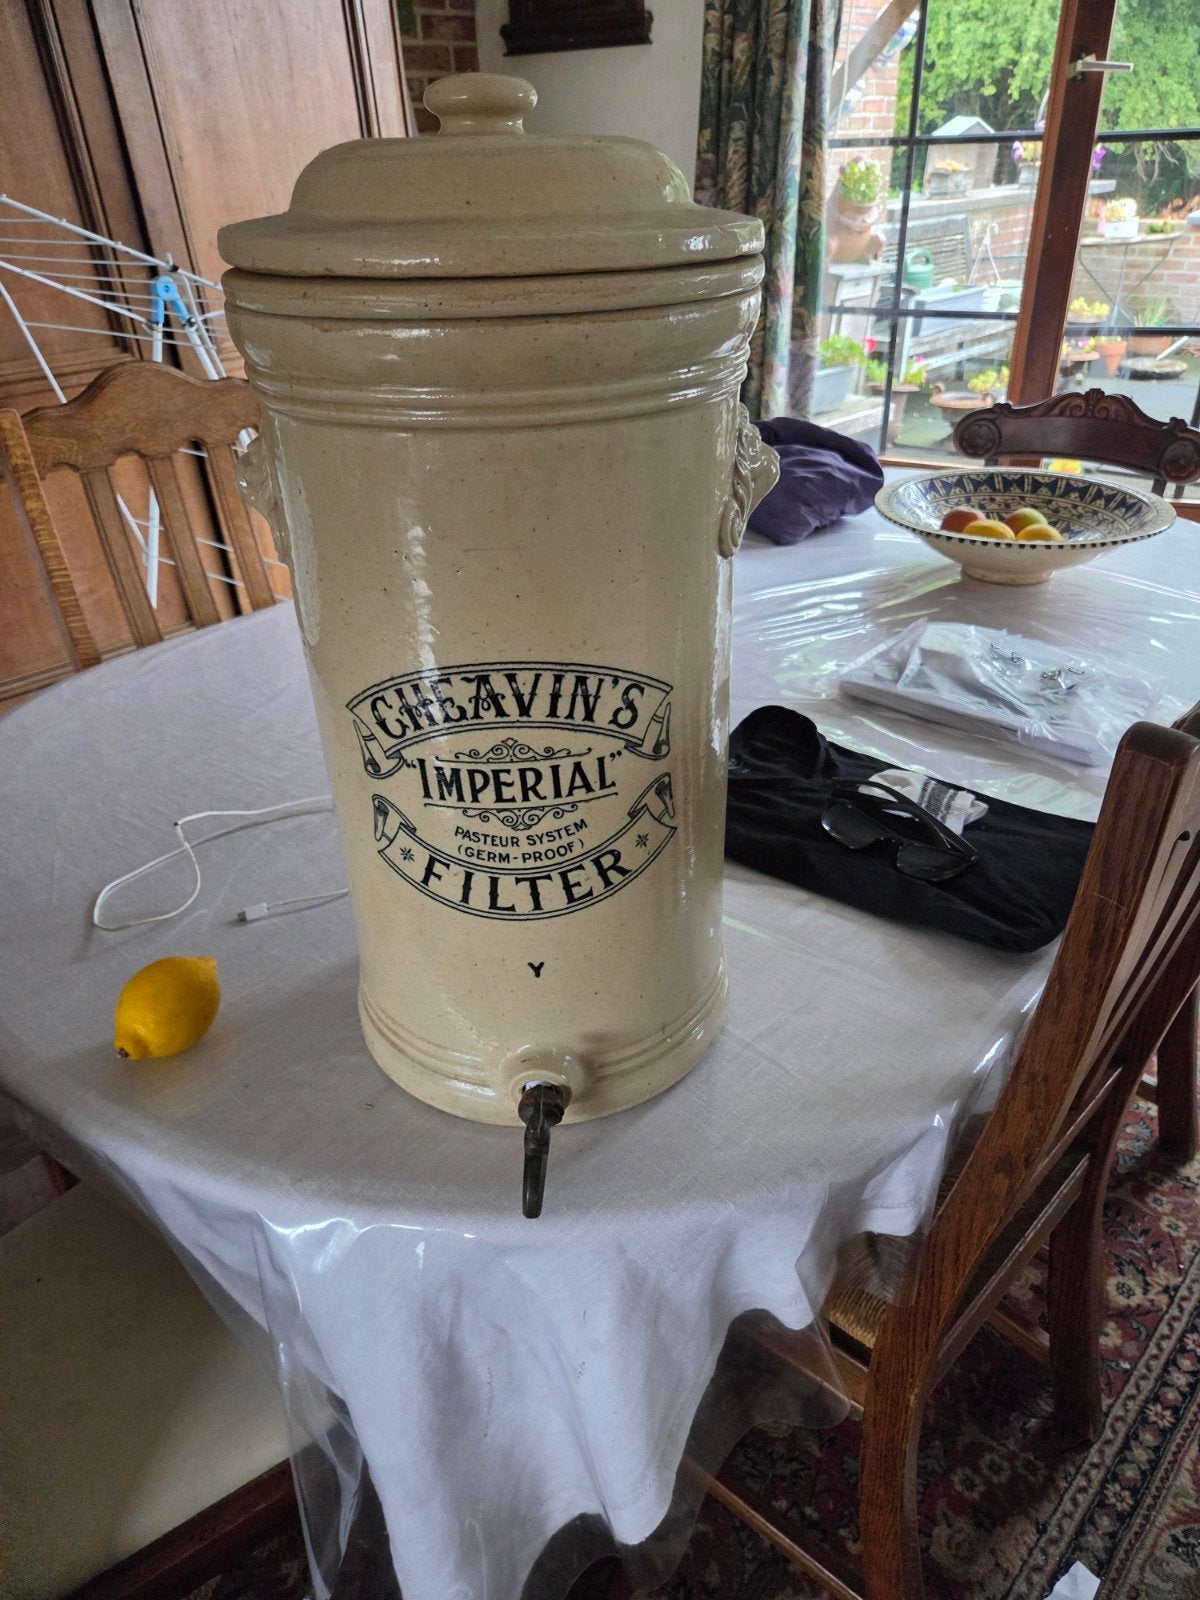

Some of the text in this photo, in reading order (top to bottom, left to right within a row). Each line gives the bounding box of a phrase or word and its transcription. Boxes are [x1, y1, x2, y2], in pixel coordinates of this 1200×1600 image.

[370, 672, 645, 740] CHEAVIN'S
[454, 818, 588, 847] PASTEUR SYSTEM
[457, 838, 585, 864] (GERM-PROOF)
[420, 848, 633, 912] FILTER
[528, 961, 545, 978] Y
